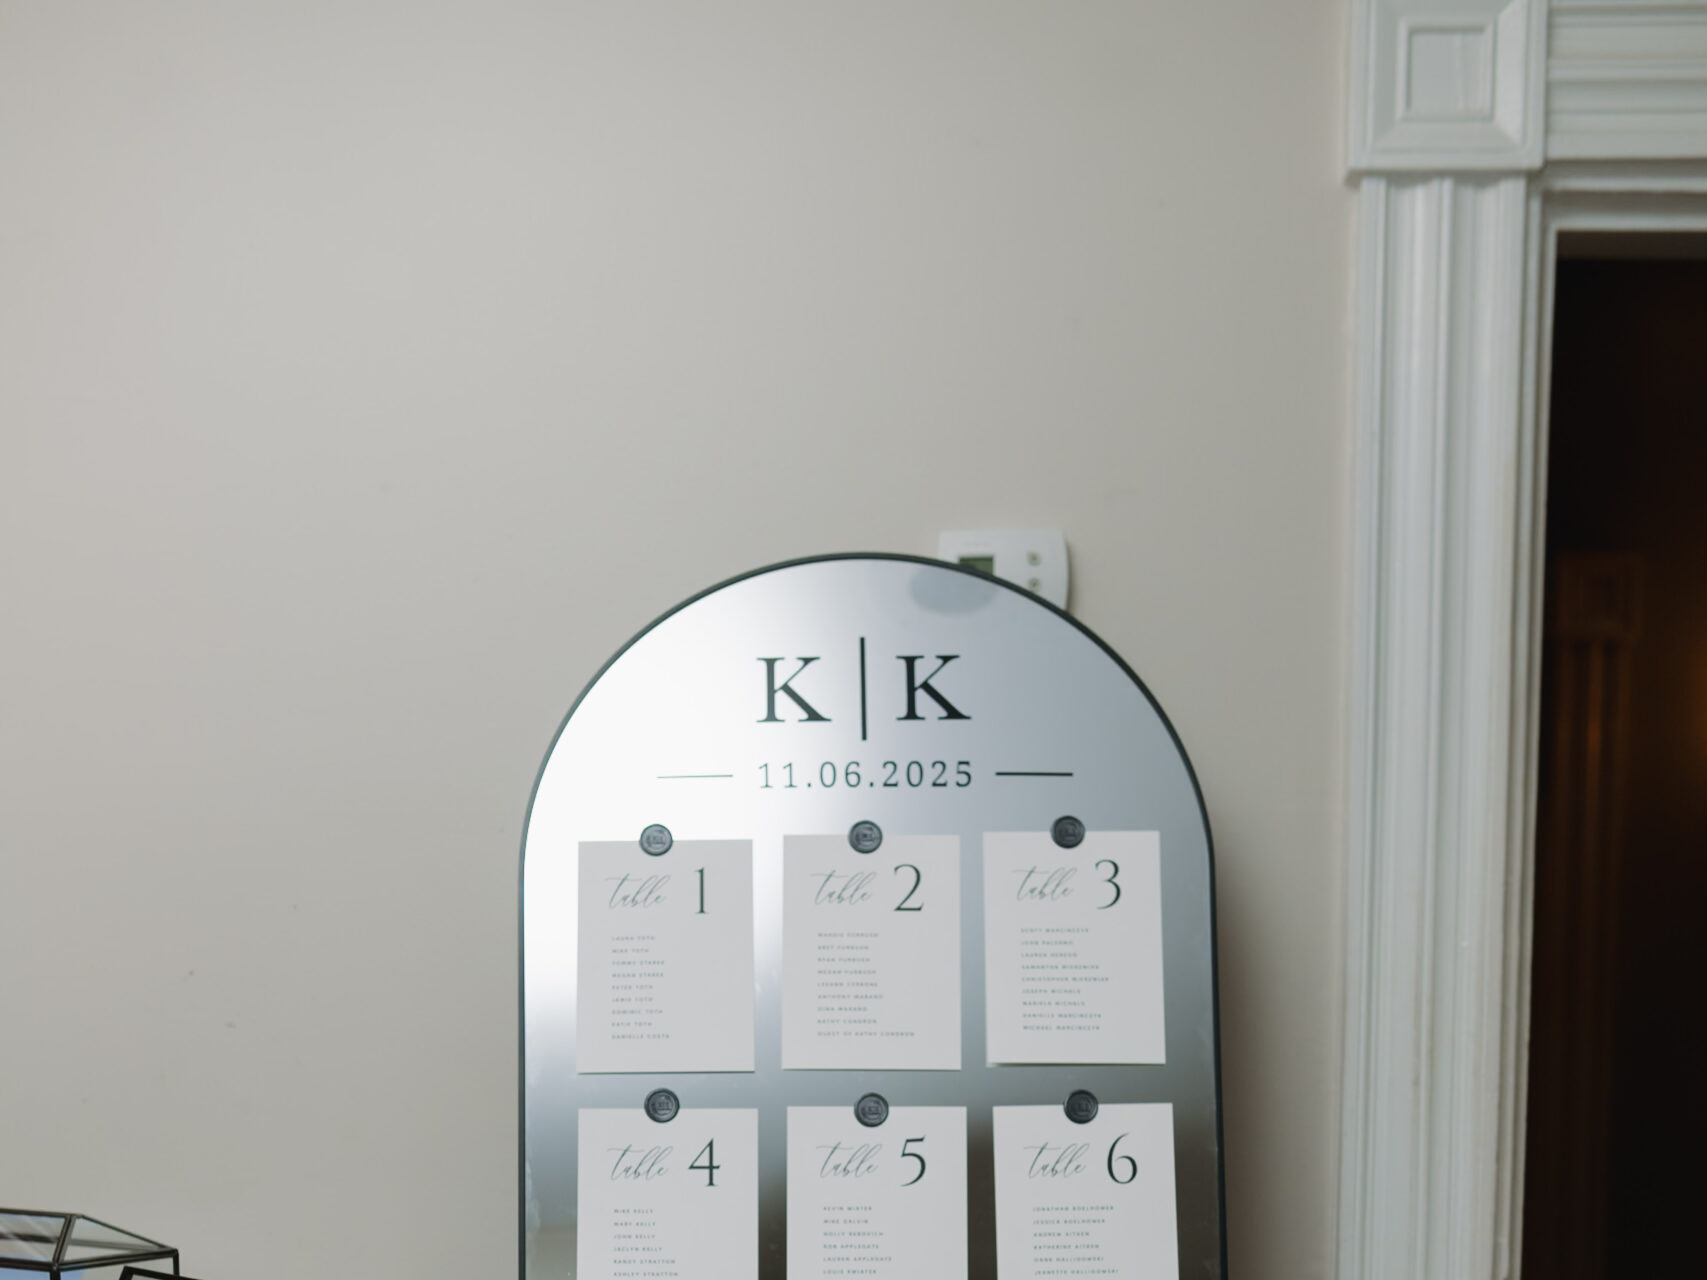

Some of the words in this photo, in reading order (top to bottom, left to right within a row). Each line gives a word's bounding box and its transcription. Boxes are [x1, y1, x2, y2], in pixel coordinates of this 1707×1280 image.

[757, 657, 832, 722] K
[896, 655, 971, 721] K
[760, 761, 971, 788] 11.06.2025
[605, 873, 671, 908] table
[695, 867, 710, 914] 1
[812, 868, 877, 905] table
[894, 864, 923, 911] 2
[1014, 866, 1077, 901] table
[1095, 859, 1121, 909] 3
[607, 1144, 673, 1181] table
[688, 1138, 720, 1187] 4
[816, 1141, 882, 1178] table
[901, 1136, 926, 1186] 5
[1024, 1141, 1090, 1179] table
[1107, 1134, 1138, 1184] 6
